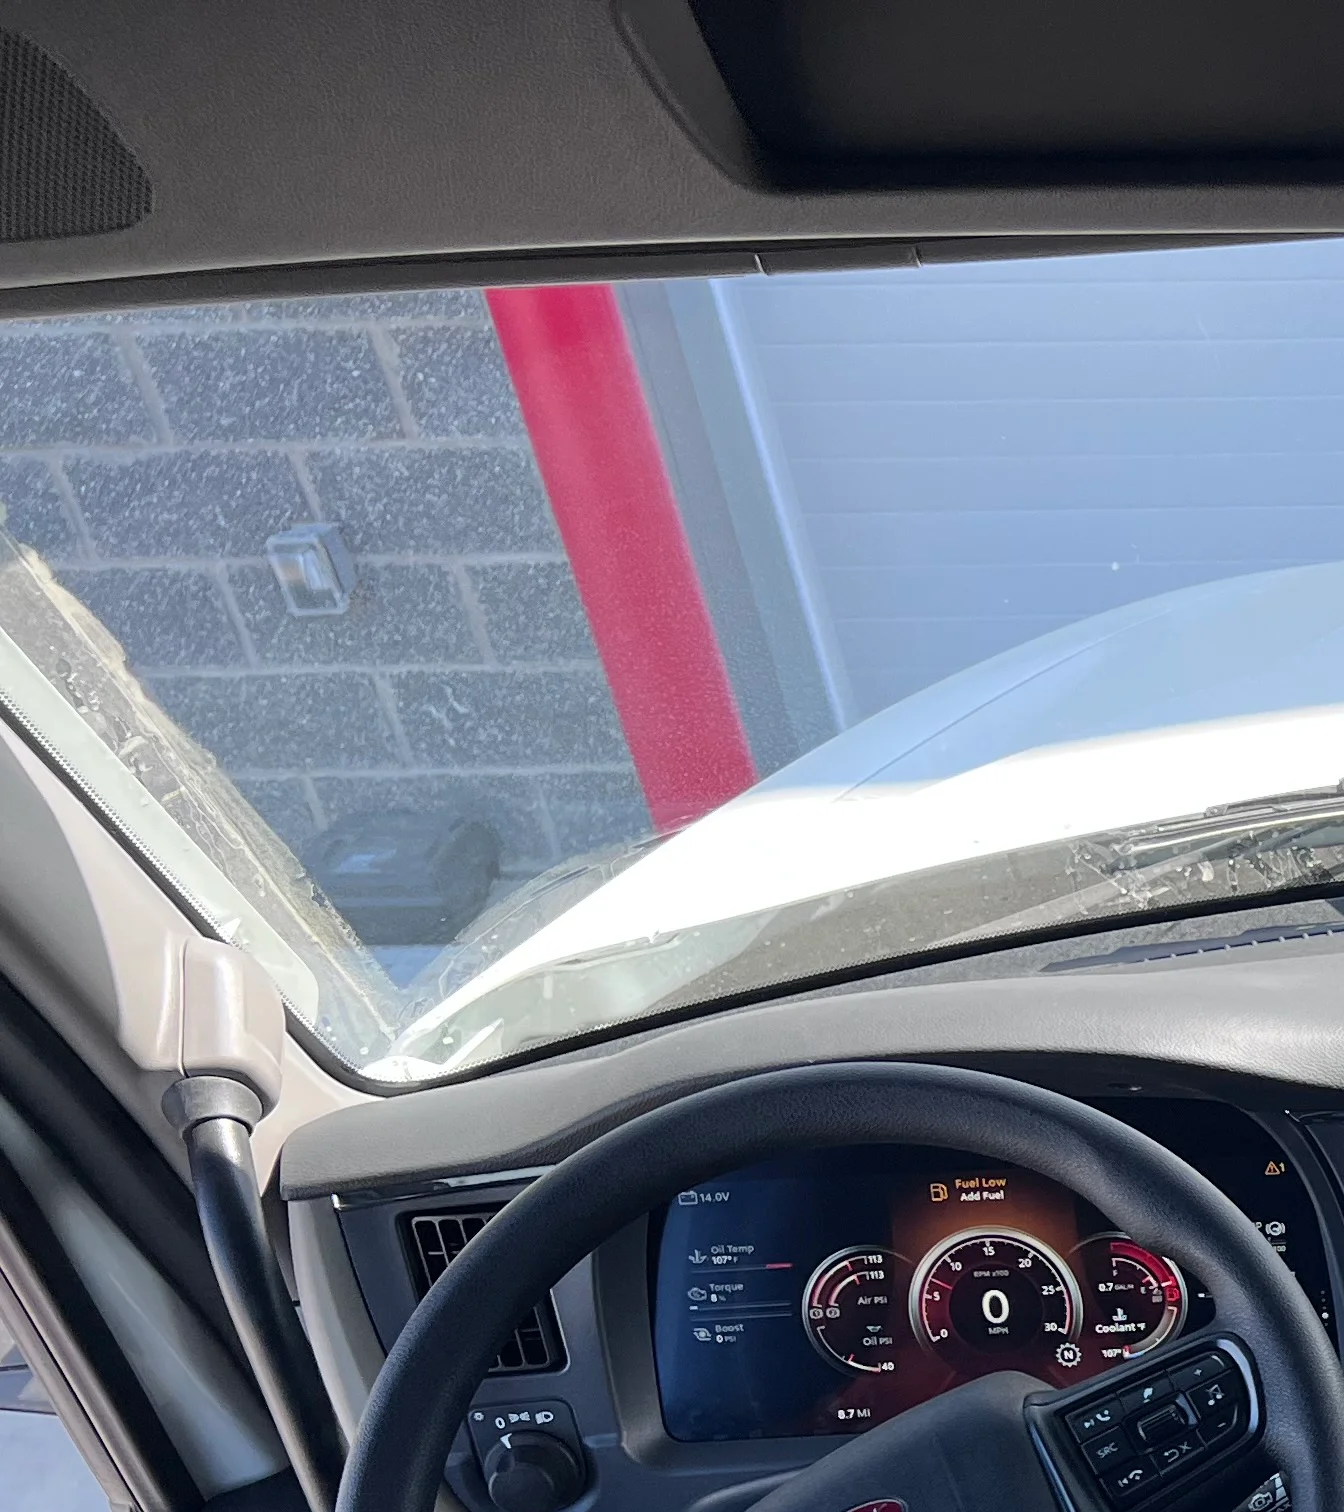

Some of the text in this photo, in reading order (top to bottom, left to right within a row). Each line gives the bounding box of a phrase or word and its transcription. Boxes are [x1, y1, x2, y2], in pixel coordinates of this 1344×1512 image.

[955, 1177, 1007, 1189] Fuel Low
[700, 1191, 730, 1203] 14.0V
[960, 1190, 1005, 1201] Add Fuel
[711, 1244, 754, 1256] Oil Temp
[982, 1246, 996, 1257] 15
[950, 1261, 963, 1272] 10
[1018, 1258, 1032, 1269] 20
[709, 1283, 744, 1295] Torque
[1041, 1285, 1056, 1296] 25
[858, 1295, 888, 1305] Air PSI
[932, 1291, 941, 1302] 5
[981, 1289, 1010, 1325] 0
[715, 1323, 744, 1334] Boost
[988, 1326, 1010, 1336] MPH
[1044, 1322, 1058, 1333] 30
[1094, 1322, 1137, 1335] Coolant
[939, 1328, 949, 1339] 0
[863, 1337, 893, 1347] Oil PSI
[1096, 1441, 1119, 1459] SRC
